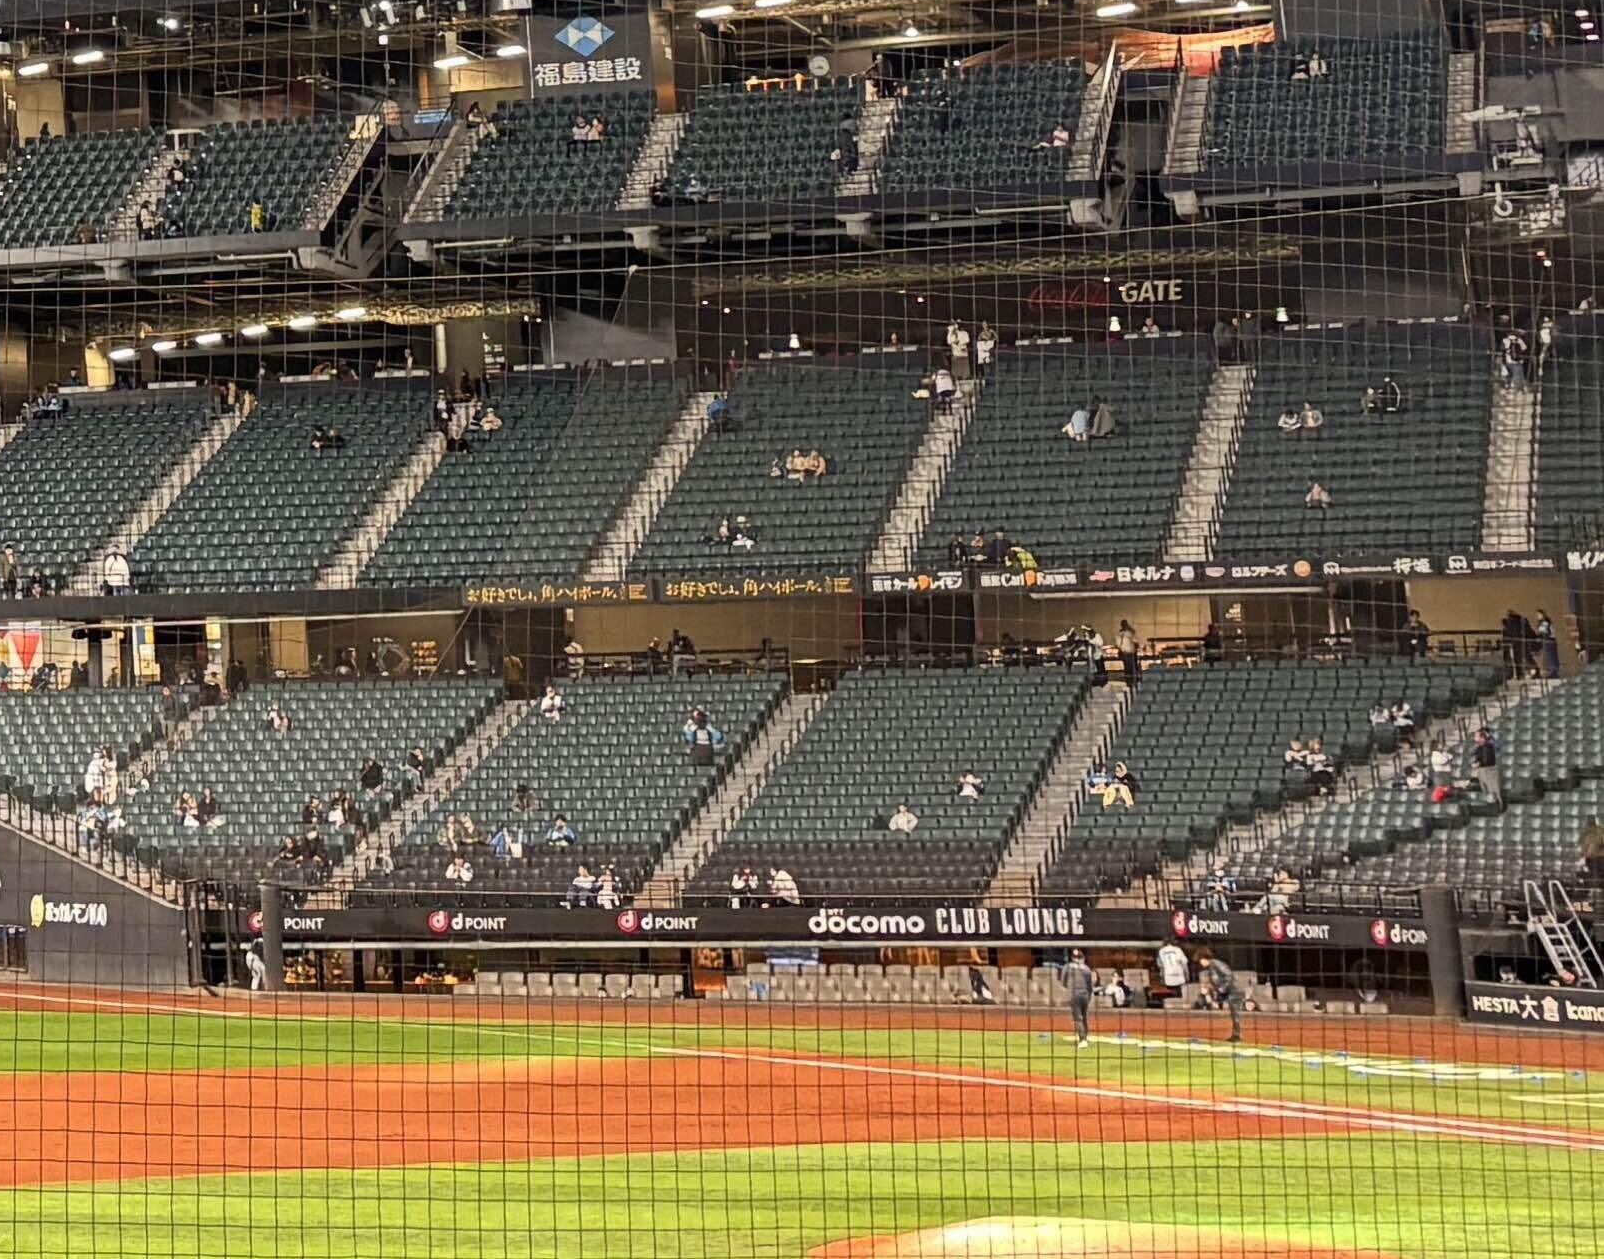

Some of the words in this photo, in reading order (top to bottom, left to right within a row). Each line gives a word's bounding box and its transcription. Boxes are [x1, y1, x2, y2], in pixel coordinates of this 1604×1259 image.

[535, 56, 642, 88] 福島建設
[1121, 278, 1183, 305] GATE
[1117, 567, 1176, 583] 日本ルナ
[284, 917, 324, 930] POINT
[466, 917, 506, 931] POINT
[655, 917, 698, 930] POINT
[808, 908, 925, 935] docomo
[935, 907, 990, 935] CLUB
[1000, 907, 1084, 935] LOUNGE
[1199, 920, 1229, 934] POINT
[1297, 924, 1330, 940] POINT
